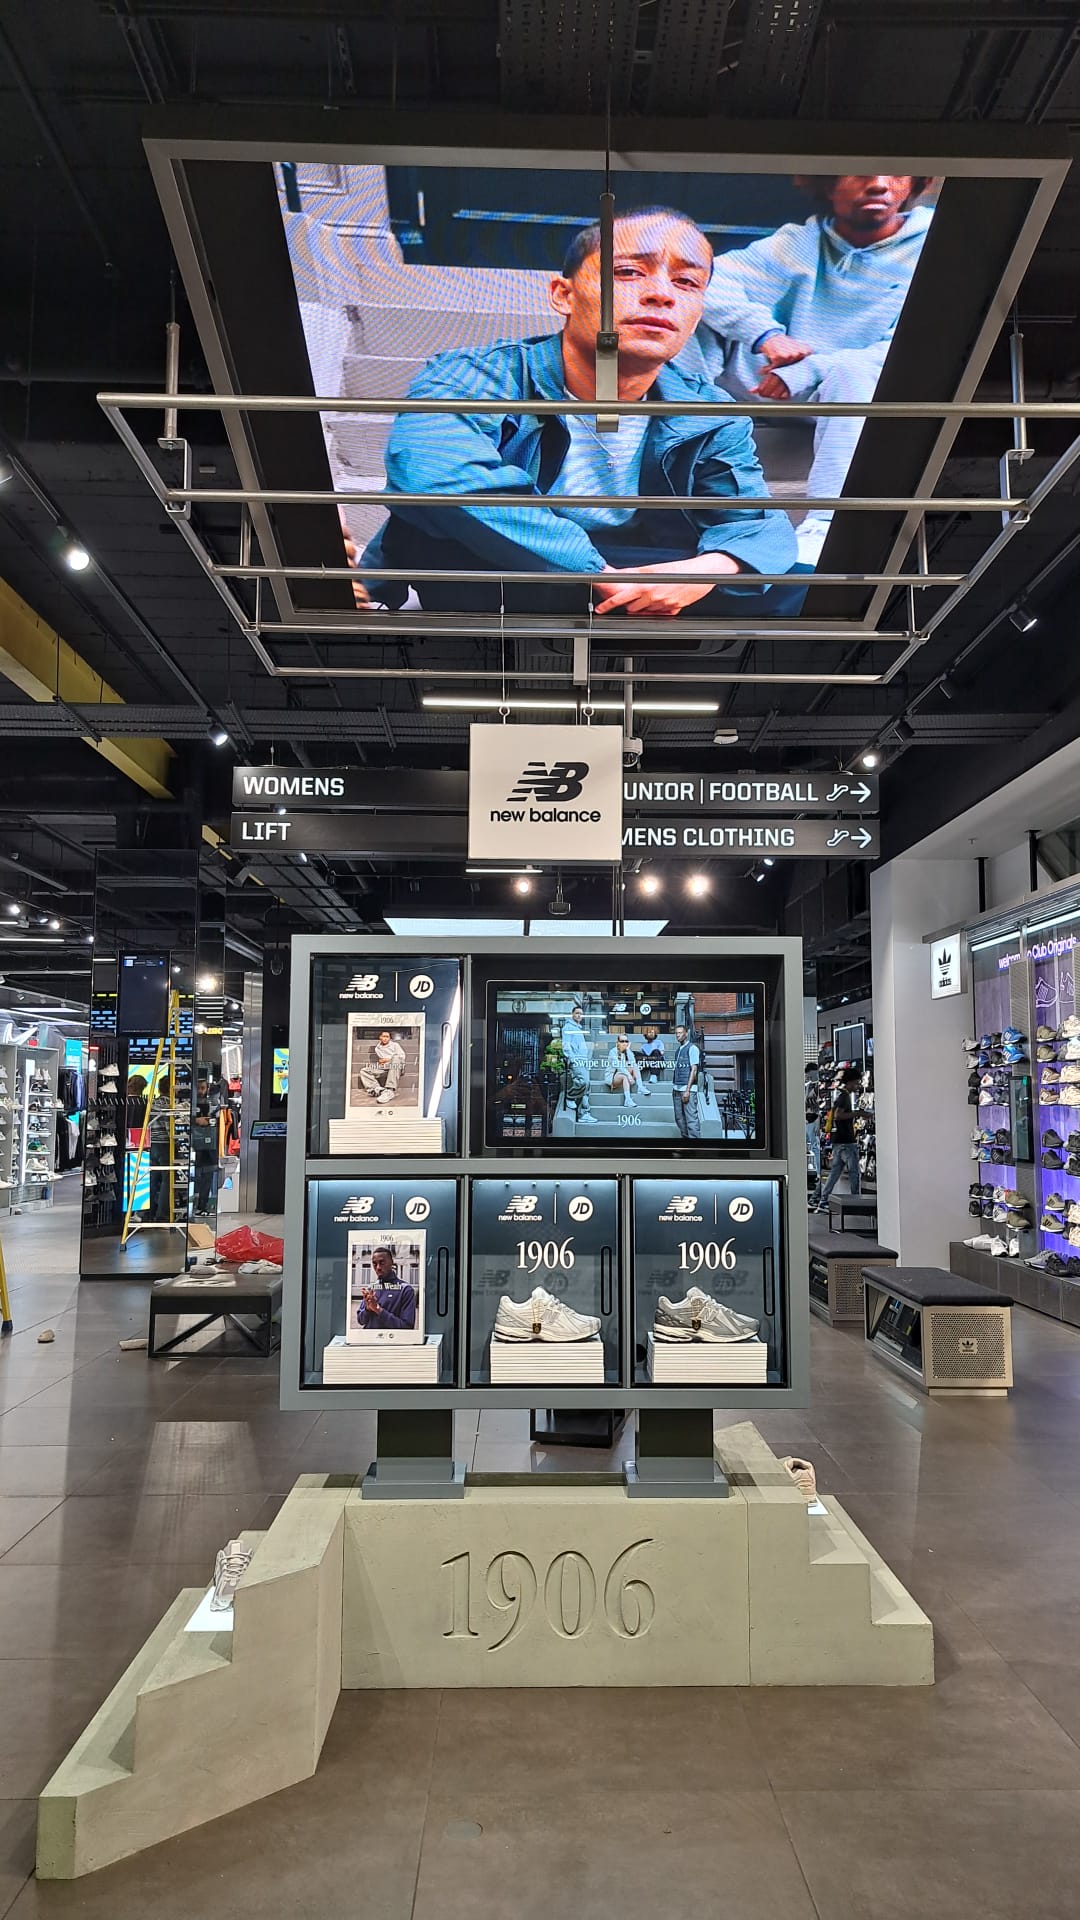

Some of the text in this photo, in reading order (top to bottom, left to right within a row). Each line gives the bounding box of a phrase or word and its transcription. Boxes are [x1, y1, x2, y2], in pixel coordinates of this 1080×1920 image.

[243, 776, 345, 796] WOMENS
[623, 782, 819, 802] UNIOR FOOTBALL
[490, 807, 602, 823] new balance
[242, 821, 292, 841] LIFT
[683, 827, 795, 847] CLOTHING
[1032, 942, 1047, 960] Club
[1047, 936, 1077, 956] Originals
[573, 1057, 599, 1070] Swipe
[601, 1058, 610, 1068] to
[637, 1058, 676, 1071] giveaway
[616, 1112, 641, 1128] 1906
[673, 1214, 703, 1222] balance
[516, 1236, 575, 1274] 1906
[677, 1237, 737, 1274] 1906
[440, 1538, 656, 1653] 1906
